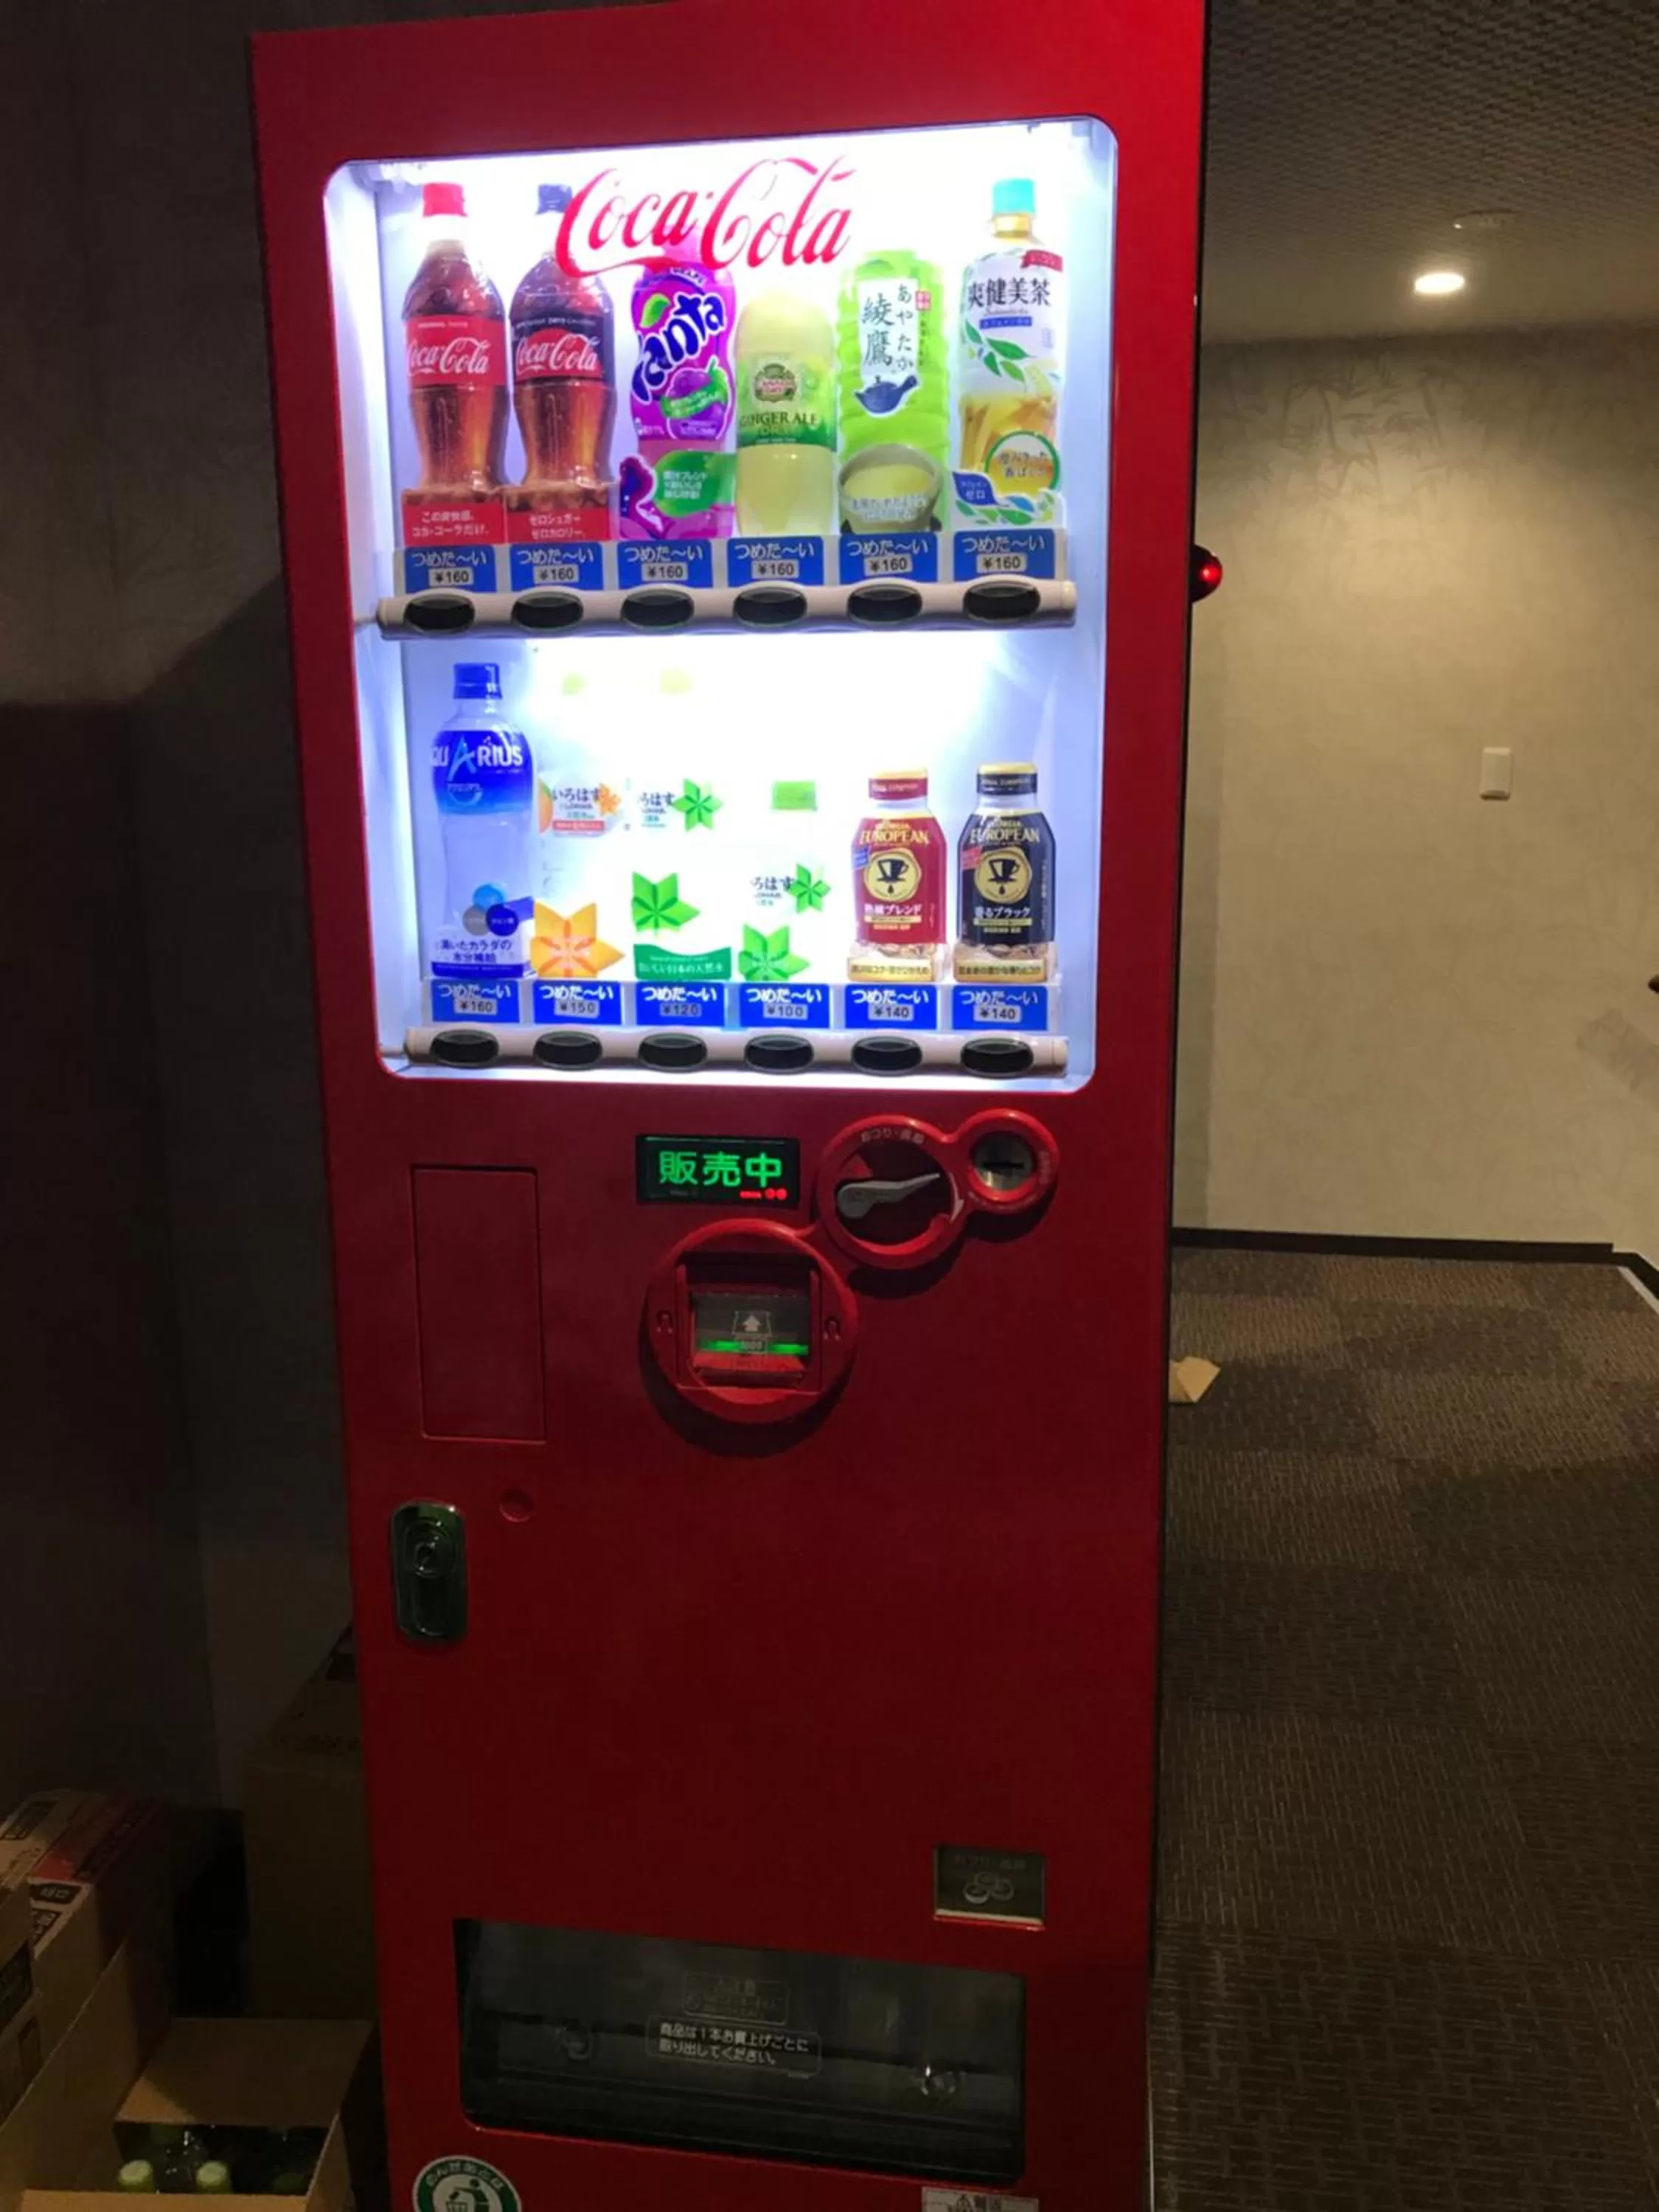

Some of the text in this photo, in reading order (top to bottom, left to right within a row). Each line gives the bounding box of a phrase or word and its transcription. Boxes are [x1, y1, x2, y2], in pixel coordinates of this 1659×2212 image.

[966, 276, 1051, 308] 爽健美茶
[795, 411, 818, 425] ALE
[870, 557, 908, 571] ¥160
[982, 555, 1021, 569] ¥160
[539, 567, 574, 580] ¥160
[647, 565, 684, 578] ¥160
[757, 563, 795, 576] ¥160
[435, 570, 469, 583] ¥160
[430, 734, 524, 782] QUARIUS
[639, 791, 675, 807] ろはす
[860, 829, 931, 845] EUROPEAN
[969, 827, 1040, 844] EUROPEAN
[750, 875, 795, 892] ろはす
[459, 1001, 493, 1013] ¥160
[559, 1001, 596, 1014] ¥150
[663, 1004, 699, 1016] ¥120
[767, 1005, 804, 1018] ¥100
[874, 1006, 910, 1019] ¥140
[979, 1007, 1016, 1020] ¥140
[658, 1150, 784, 1189] 販売中
